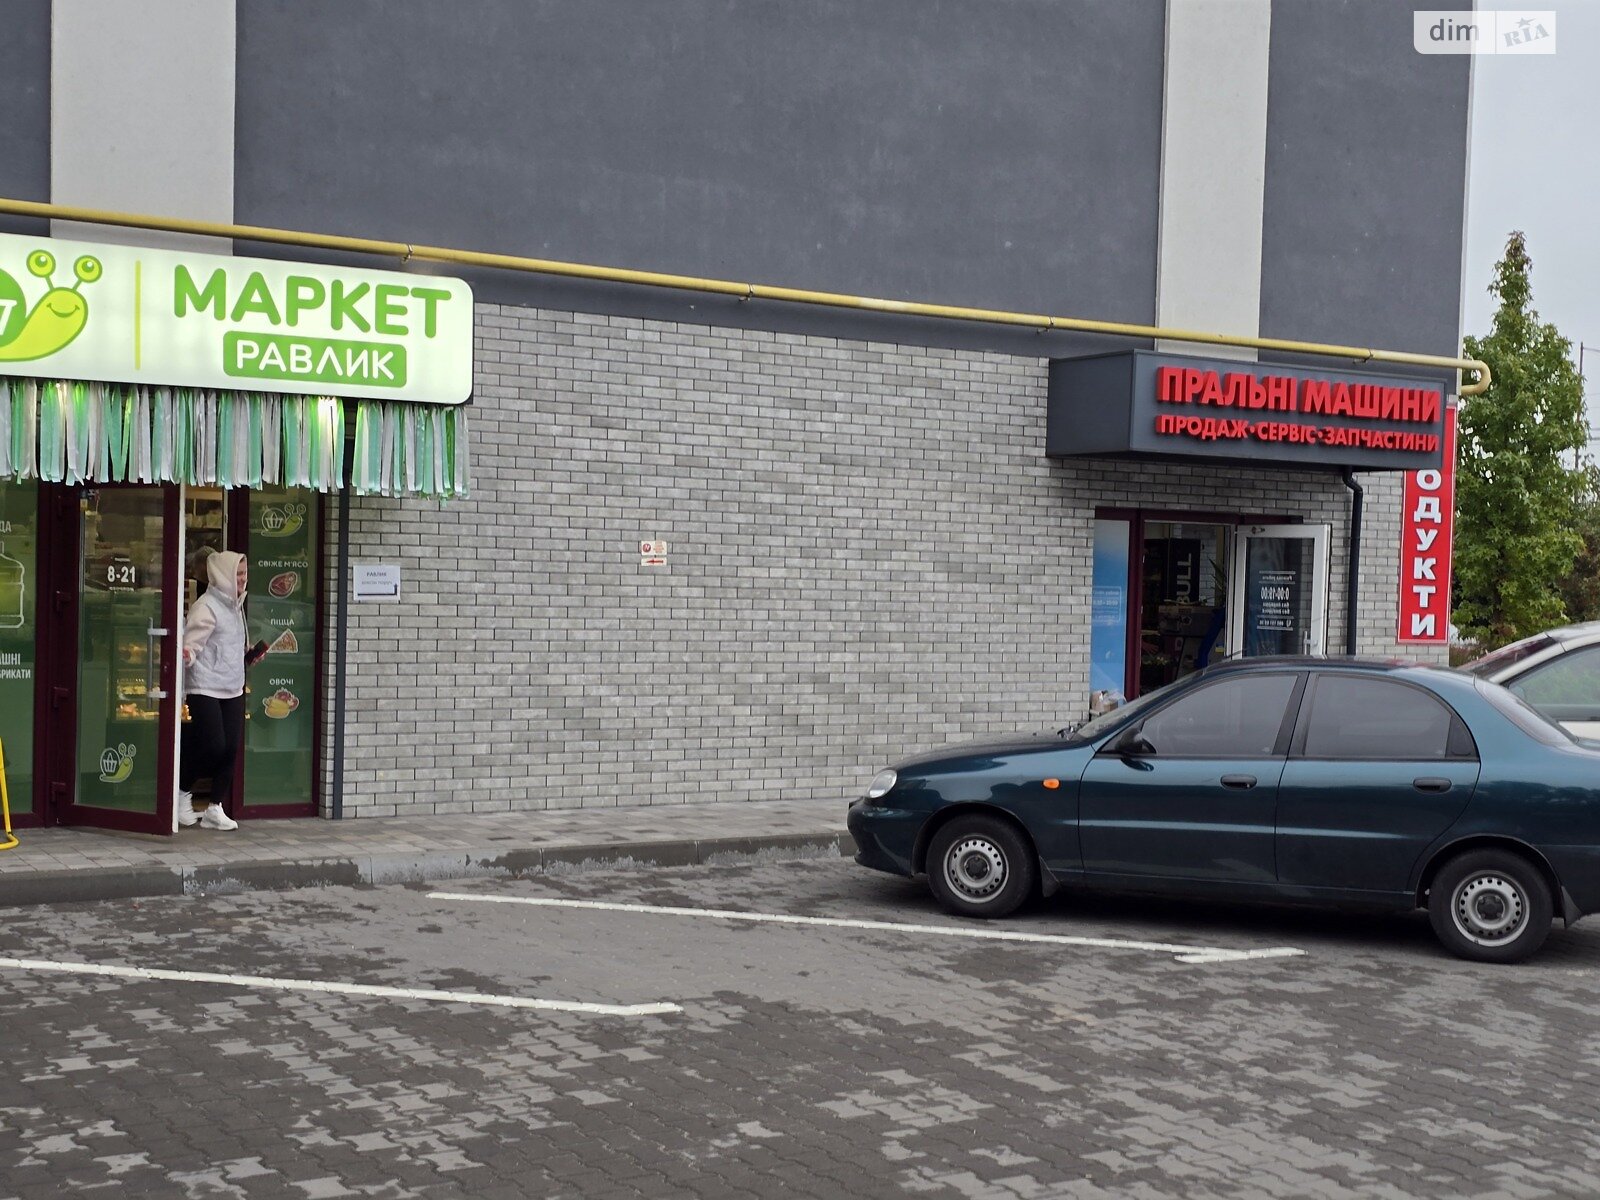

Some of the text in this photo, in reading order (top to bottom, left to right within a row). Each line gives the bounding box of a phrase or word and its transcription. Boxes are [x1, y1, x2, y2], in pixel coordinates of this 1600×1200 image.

[174, 264, 452, 338] МАРКЕТ
[236, 339, 395, 380] РАВЛИК
[1157, 366, 1440, 423] ПРАЛЬНІ МАШИНИ
[1156, 414, 1440, 452] ПРОДАЖ СЕРВІС ЗАПЧАСТИНИ
[1411, 469, 1442, 637] ОДУКТИ
[258, 560, 283, 568] СВІЖЕ
[107, 565, 136, 583] 8-21
[271, 618, 295, 626] ПІЦЦА
[0, 652, 21, 666] ШНІ
[0, 668, 31, 679] РИКАТИ
[269, 678, 294, 686] ОВОЧІ
